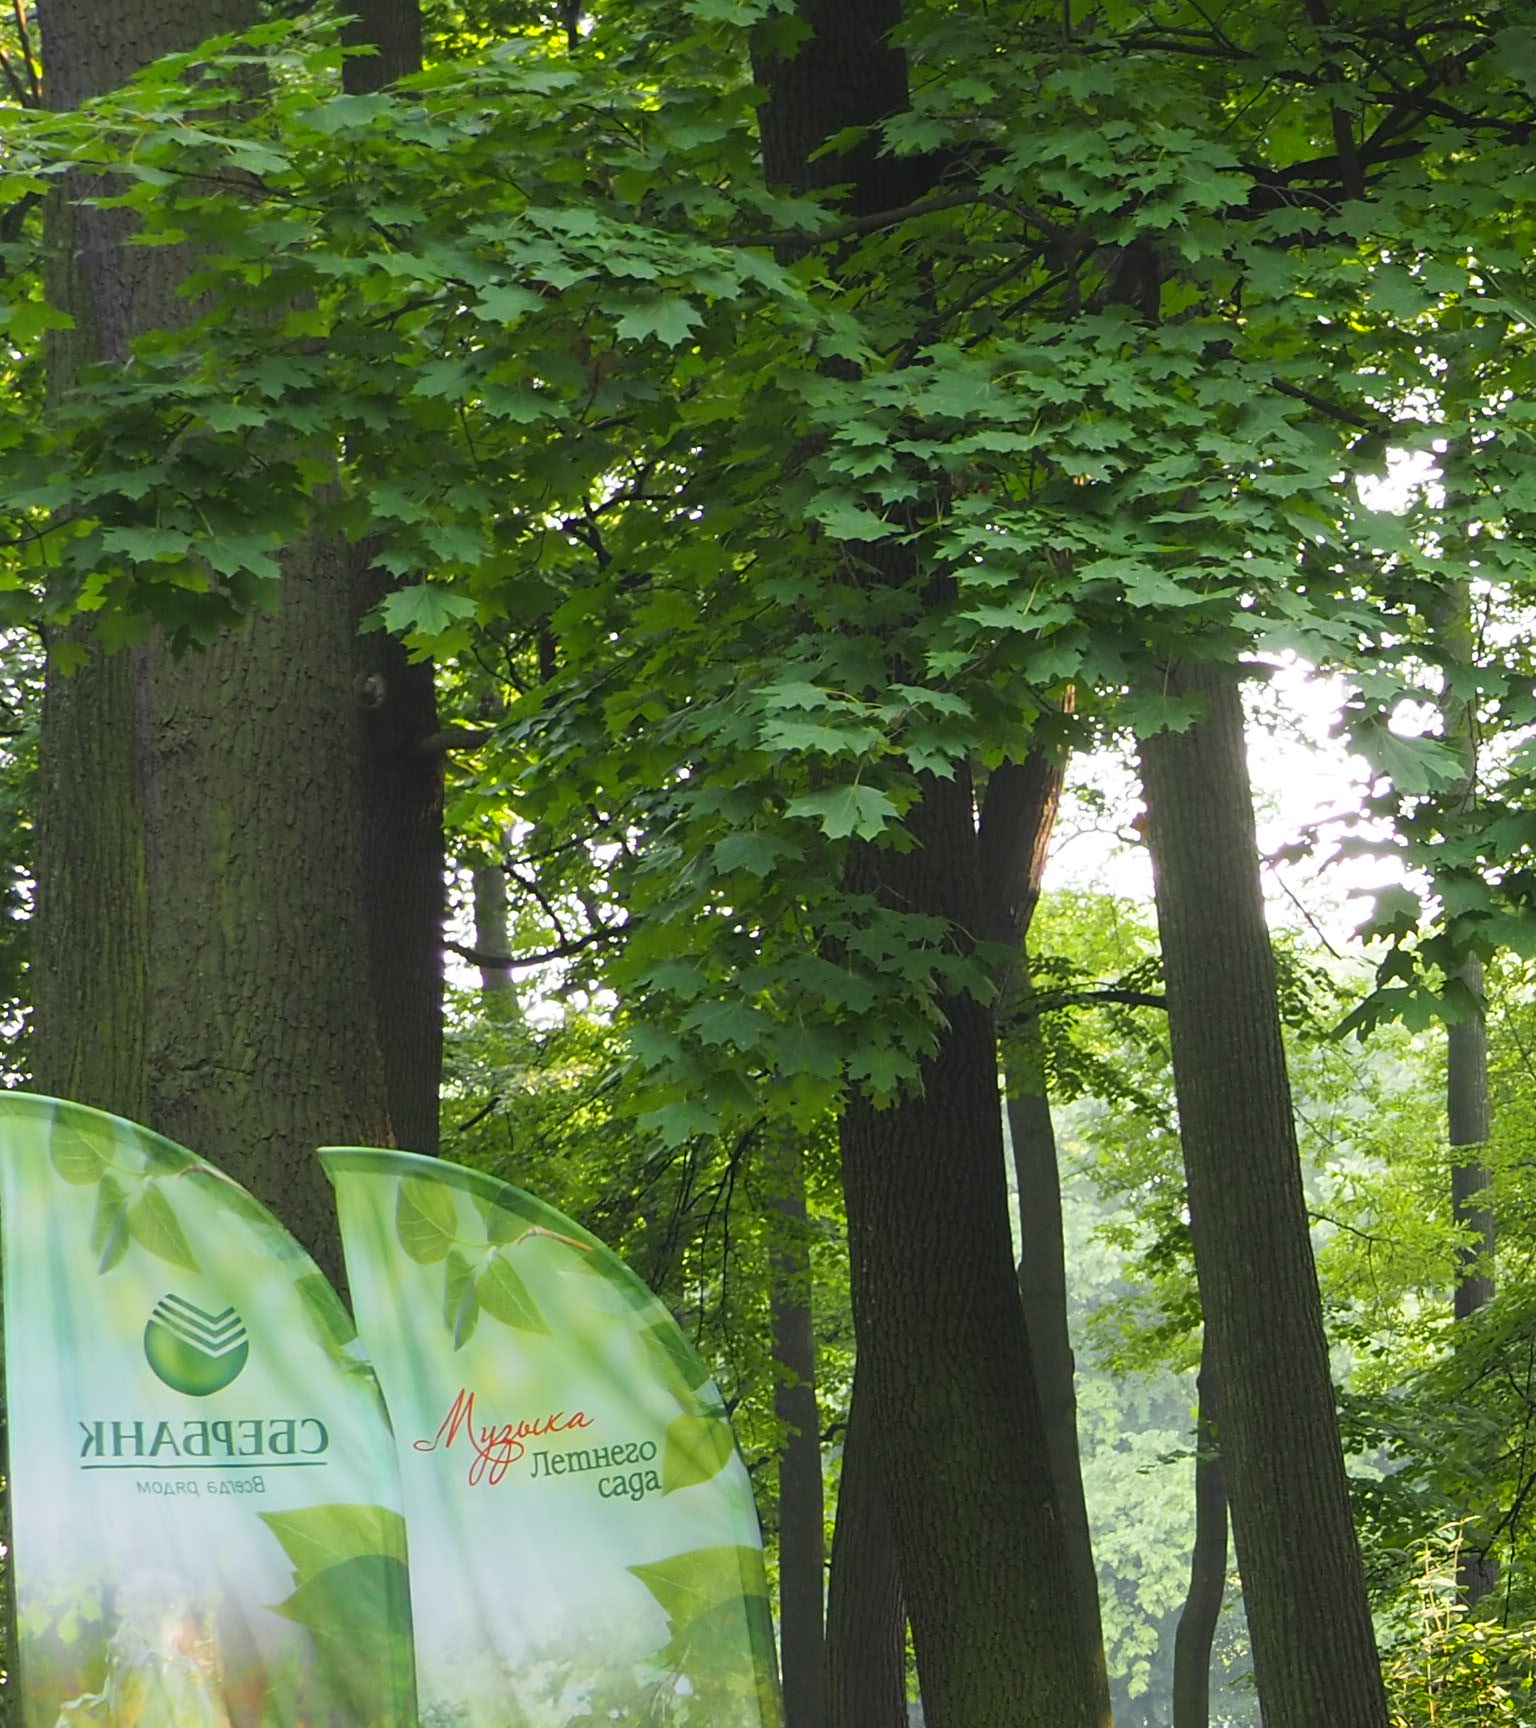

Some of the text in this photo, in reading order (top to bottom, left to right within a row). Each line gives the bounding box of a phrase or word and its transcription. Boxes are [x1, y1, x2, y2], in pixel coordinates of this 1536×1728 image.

[412, 1387, 596, 1487] Музыка
[529, 1440, 658, 1479] Летнего
[597, 1468, 662, 1502] сада
